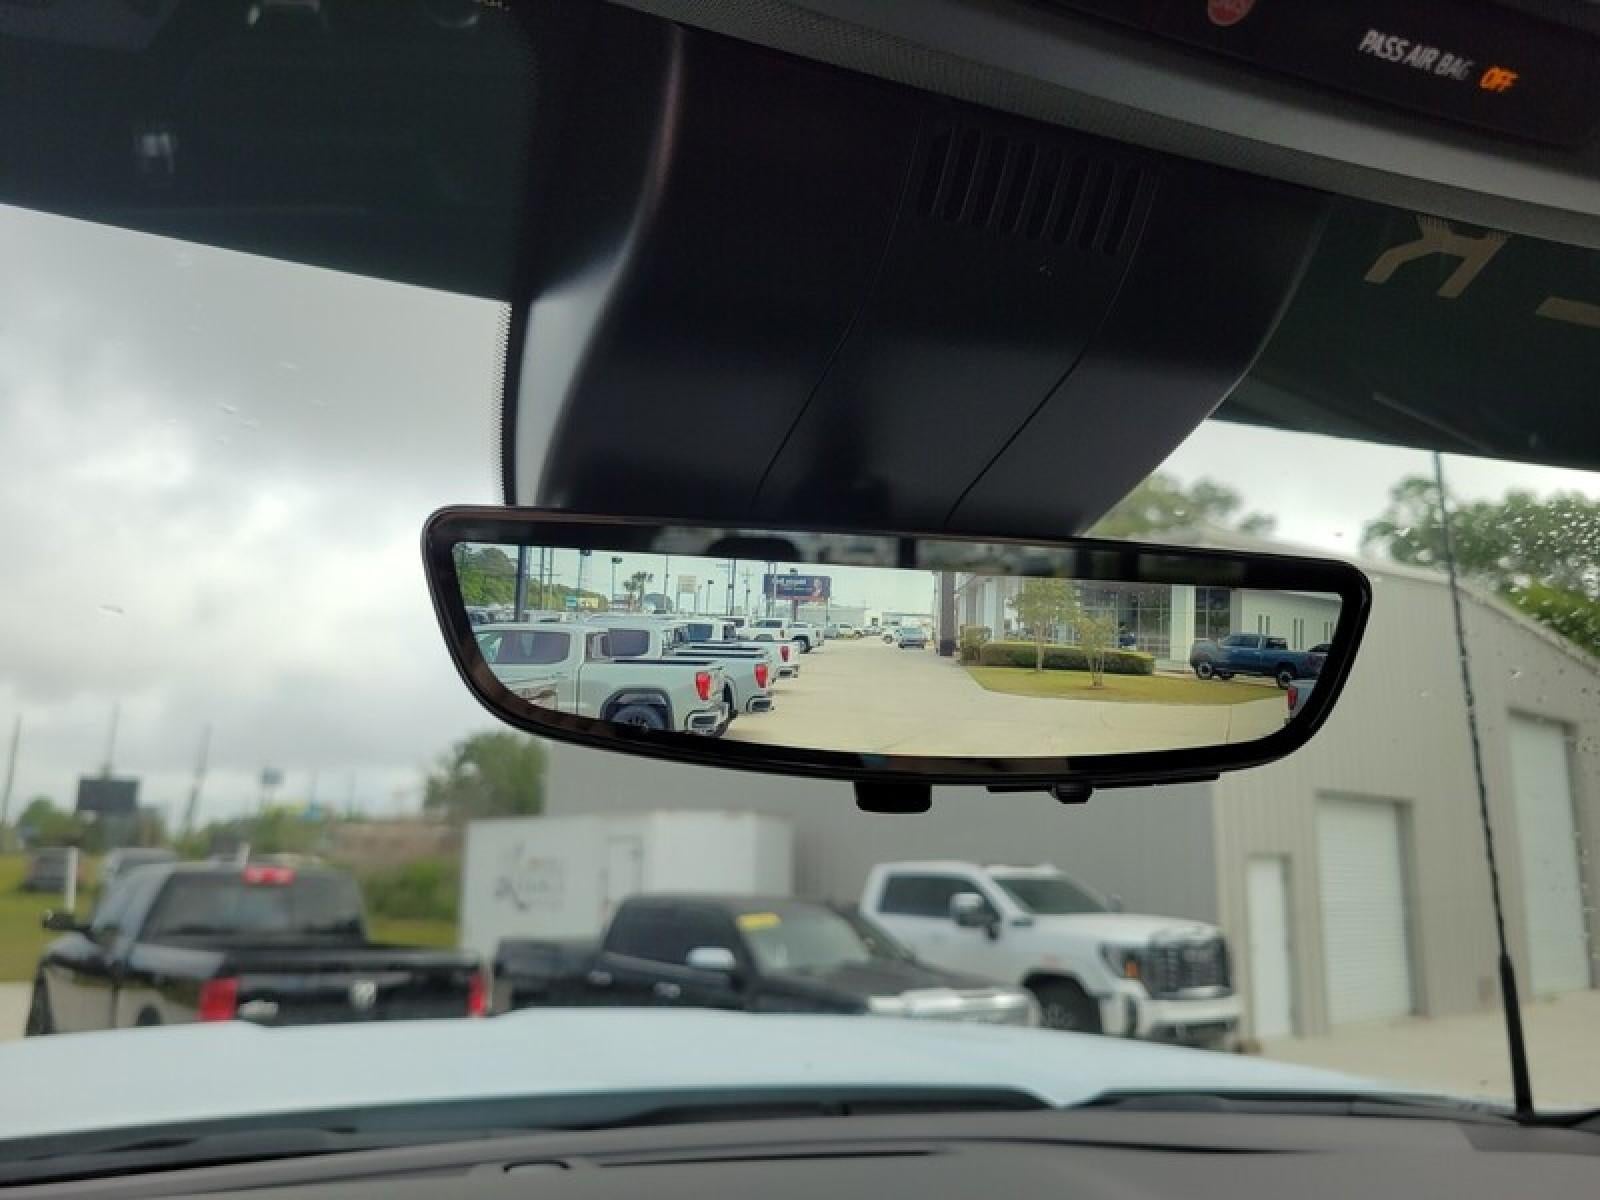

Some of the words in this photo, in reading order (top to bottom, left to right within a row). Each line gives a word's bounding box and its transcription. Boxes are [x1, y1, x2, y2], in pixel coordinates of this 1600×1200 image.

[1359, 29, 1409, 62] PASS
[1402, 44, 1440, 70] AIR
[1479, 66, 1519, 91] OFF
